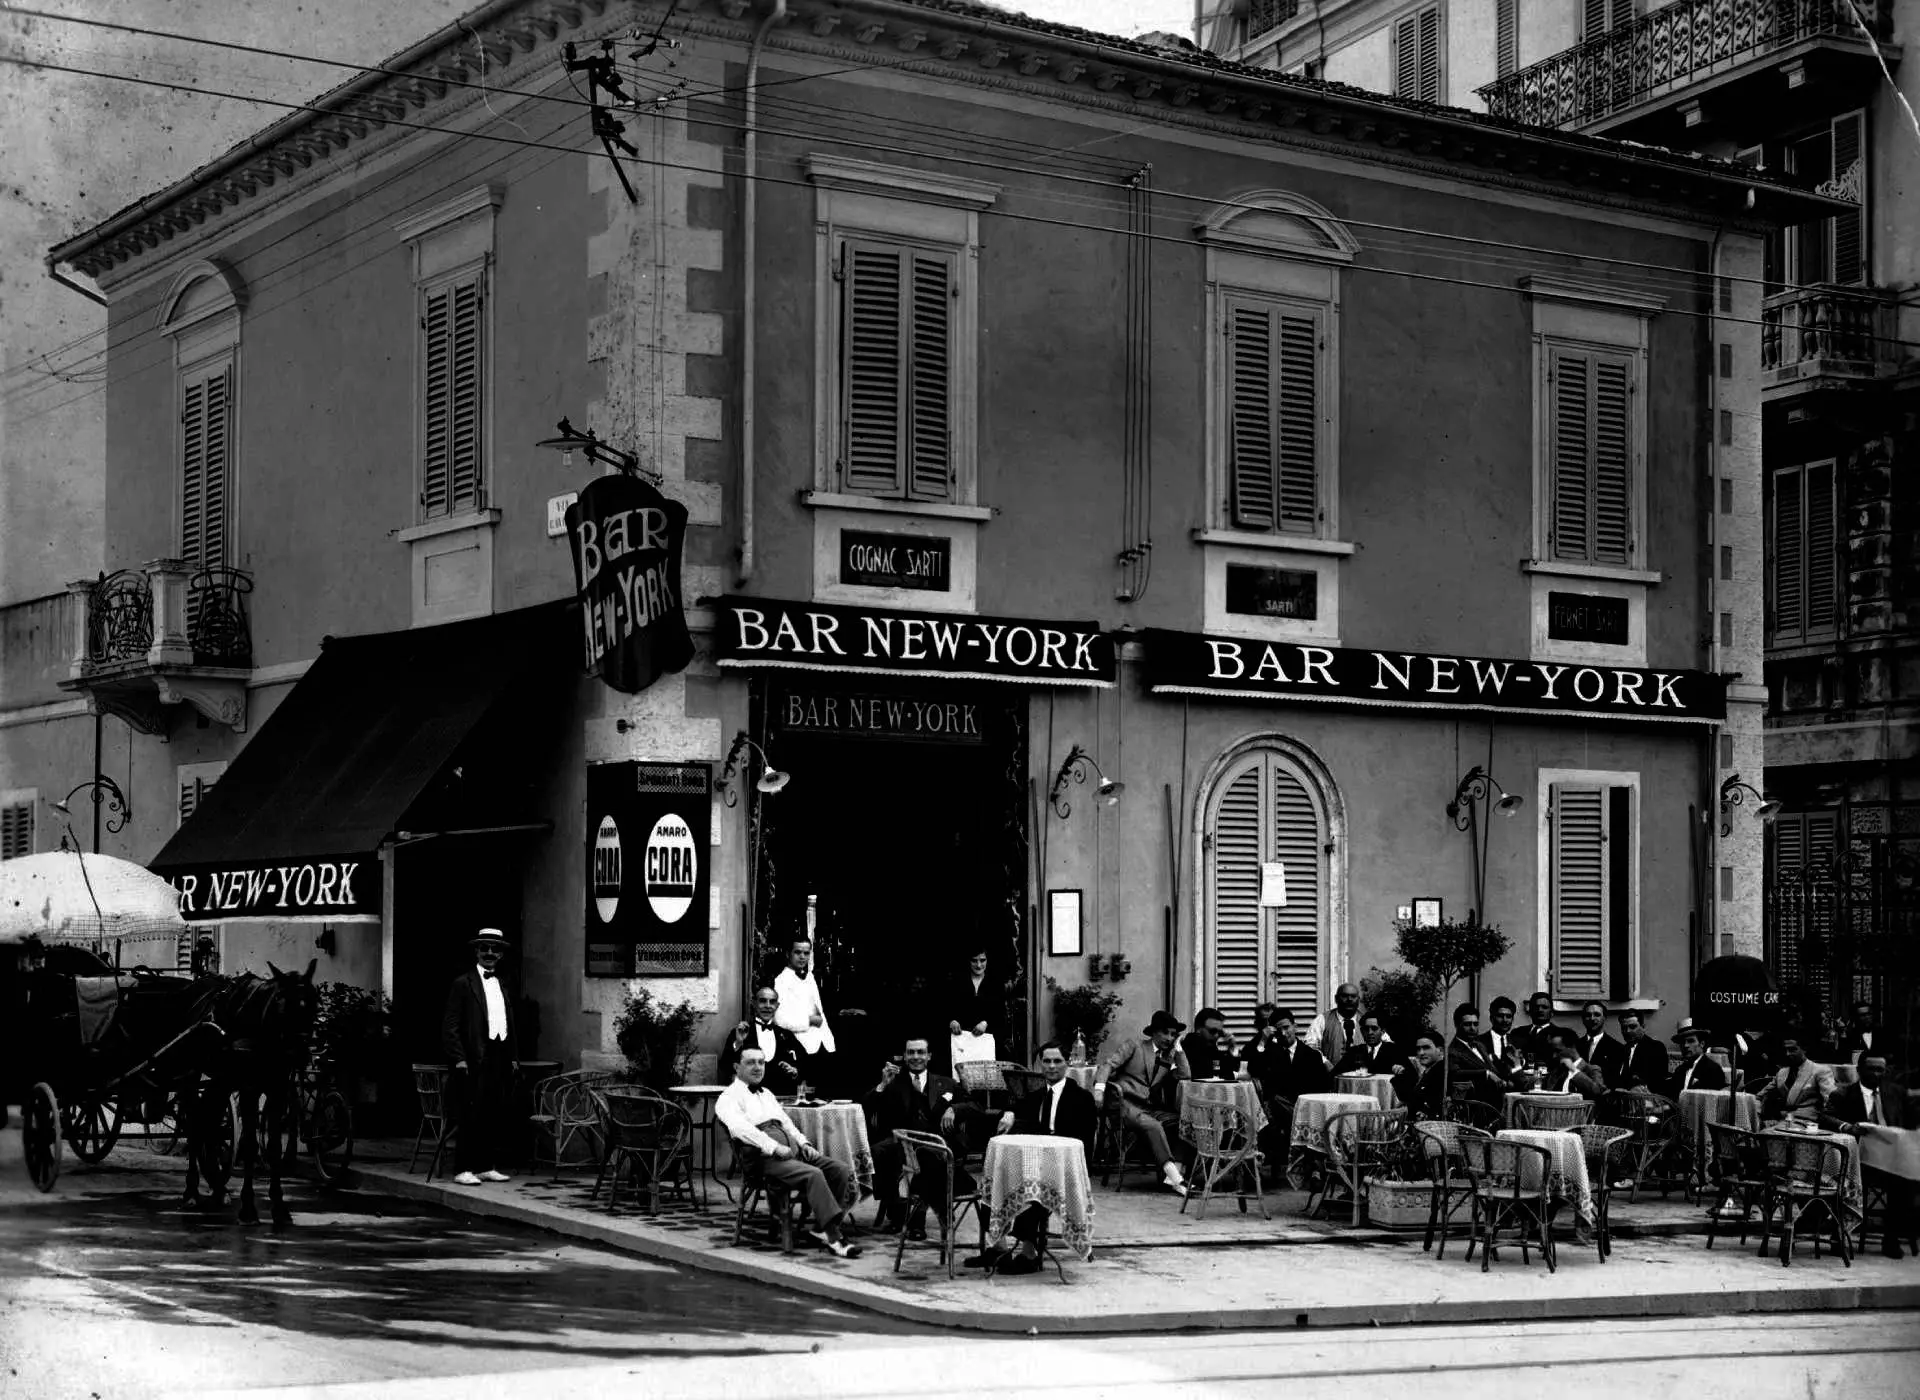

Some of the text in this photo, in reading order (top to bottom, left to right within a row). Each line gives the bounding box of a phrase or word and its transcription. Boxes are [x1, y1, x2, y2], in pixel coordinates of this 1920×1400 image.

[848, 544, 943, 577] COGNAC SARTI
[583, 557, 675, 669] NEW-YORK
[730, 607, 1102, 672] BAR NEW-YORK
[1203, 639, 1687, 709] BAR NEW-YORK
[788, 695, 838, 729] BAR
[656, 826, 687, 837] AMARO
[595, 847, 619, 883] CORA
[648, 846, 693, 883] CORA
[203, 862, 359, 911] NEW-YORK
[1710, 991, 1760, 1005] COSTUME
